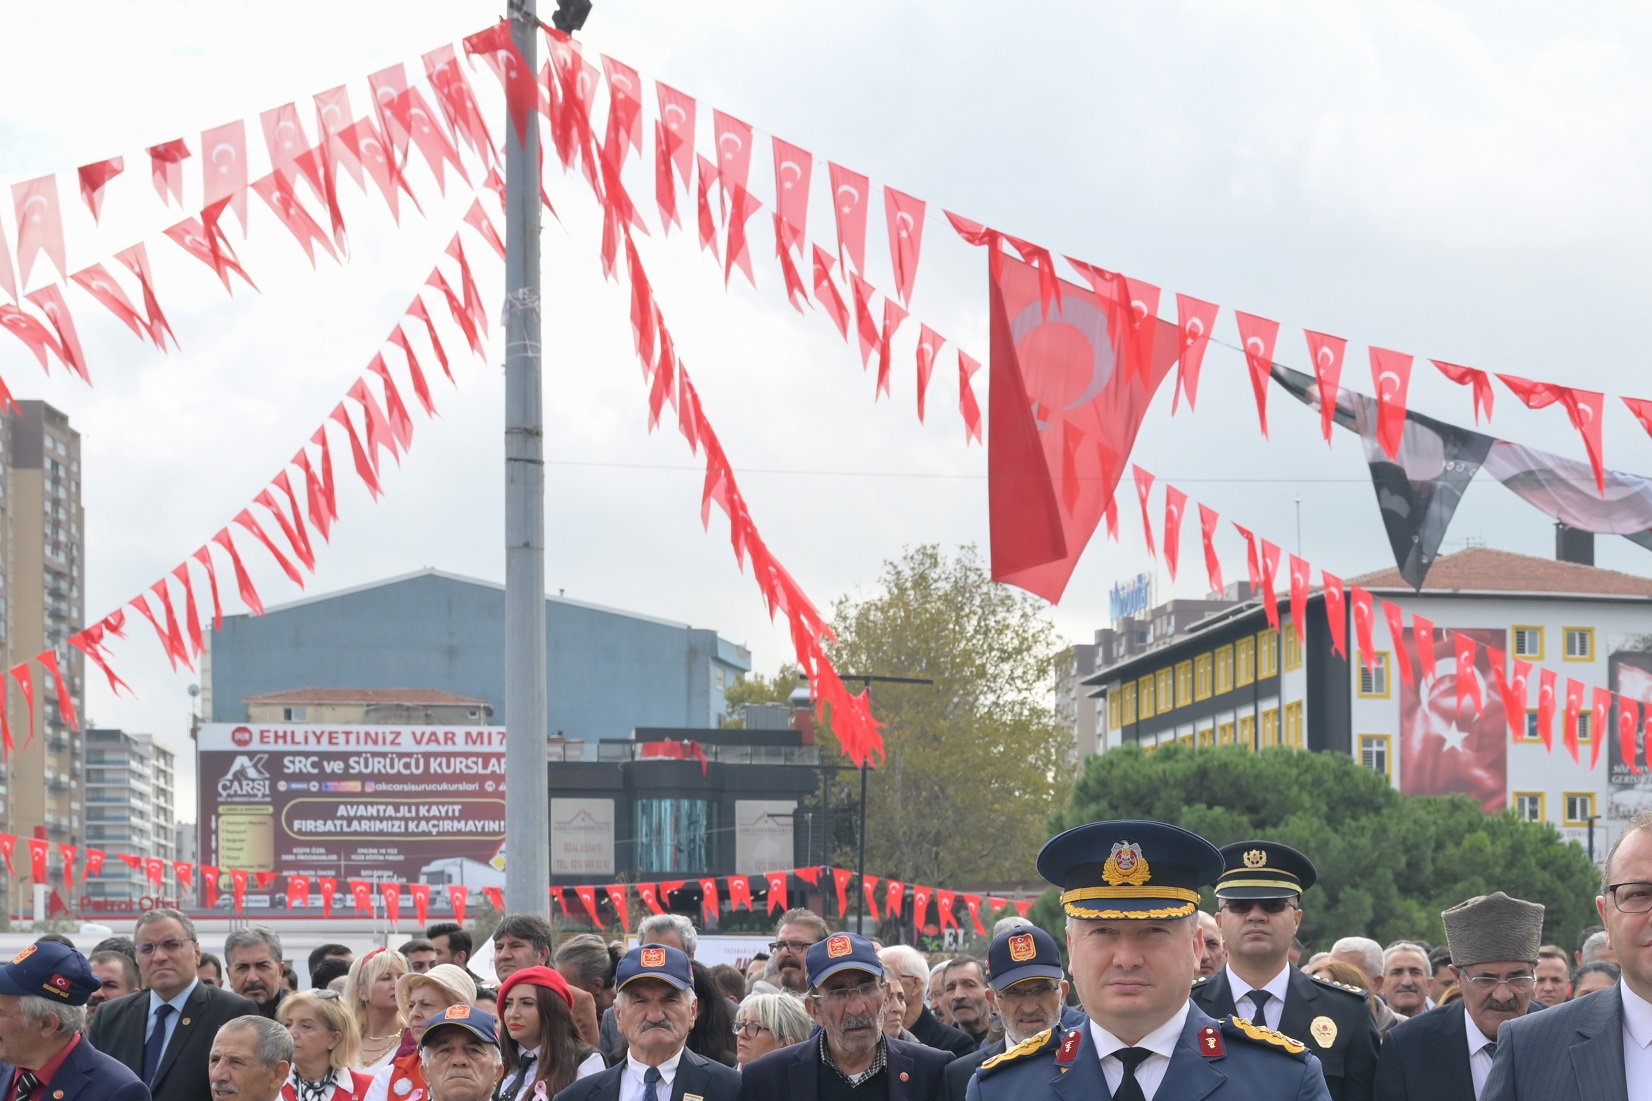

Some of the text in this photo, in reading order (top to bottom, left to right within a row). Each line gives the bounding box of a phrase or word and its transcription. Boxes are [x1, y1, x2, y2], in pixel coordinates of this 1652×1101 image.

[411, 731, 457, 746] VAR
[283, 756, 319, 774] SRC
[322, 760, 345, 774] ve
[348, 753, 424, 774] SÜRÜCÜ
[217, 780, 270, 798] ÇARŞI
[337, 804, 462, 817] AVANTAJLI KAYIT
[293, 820, 505, 835] FIRSATLARIMIZI KAÇIRMAYIN!
[80, 896, 180, 912] Petrol Ofisi
